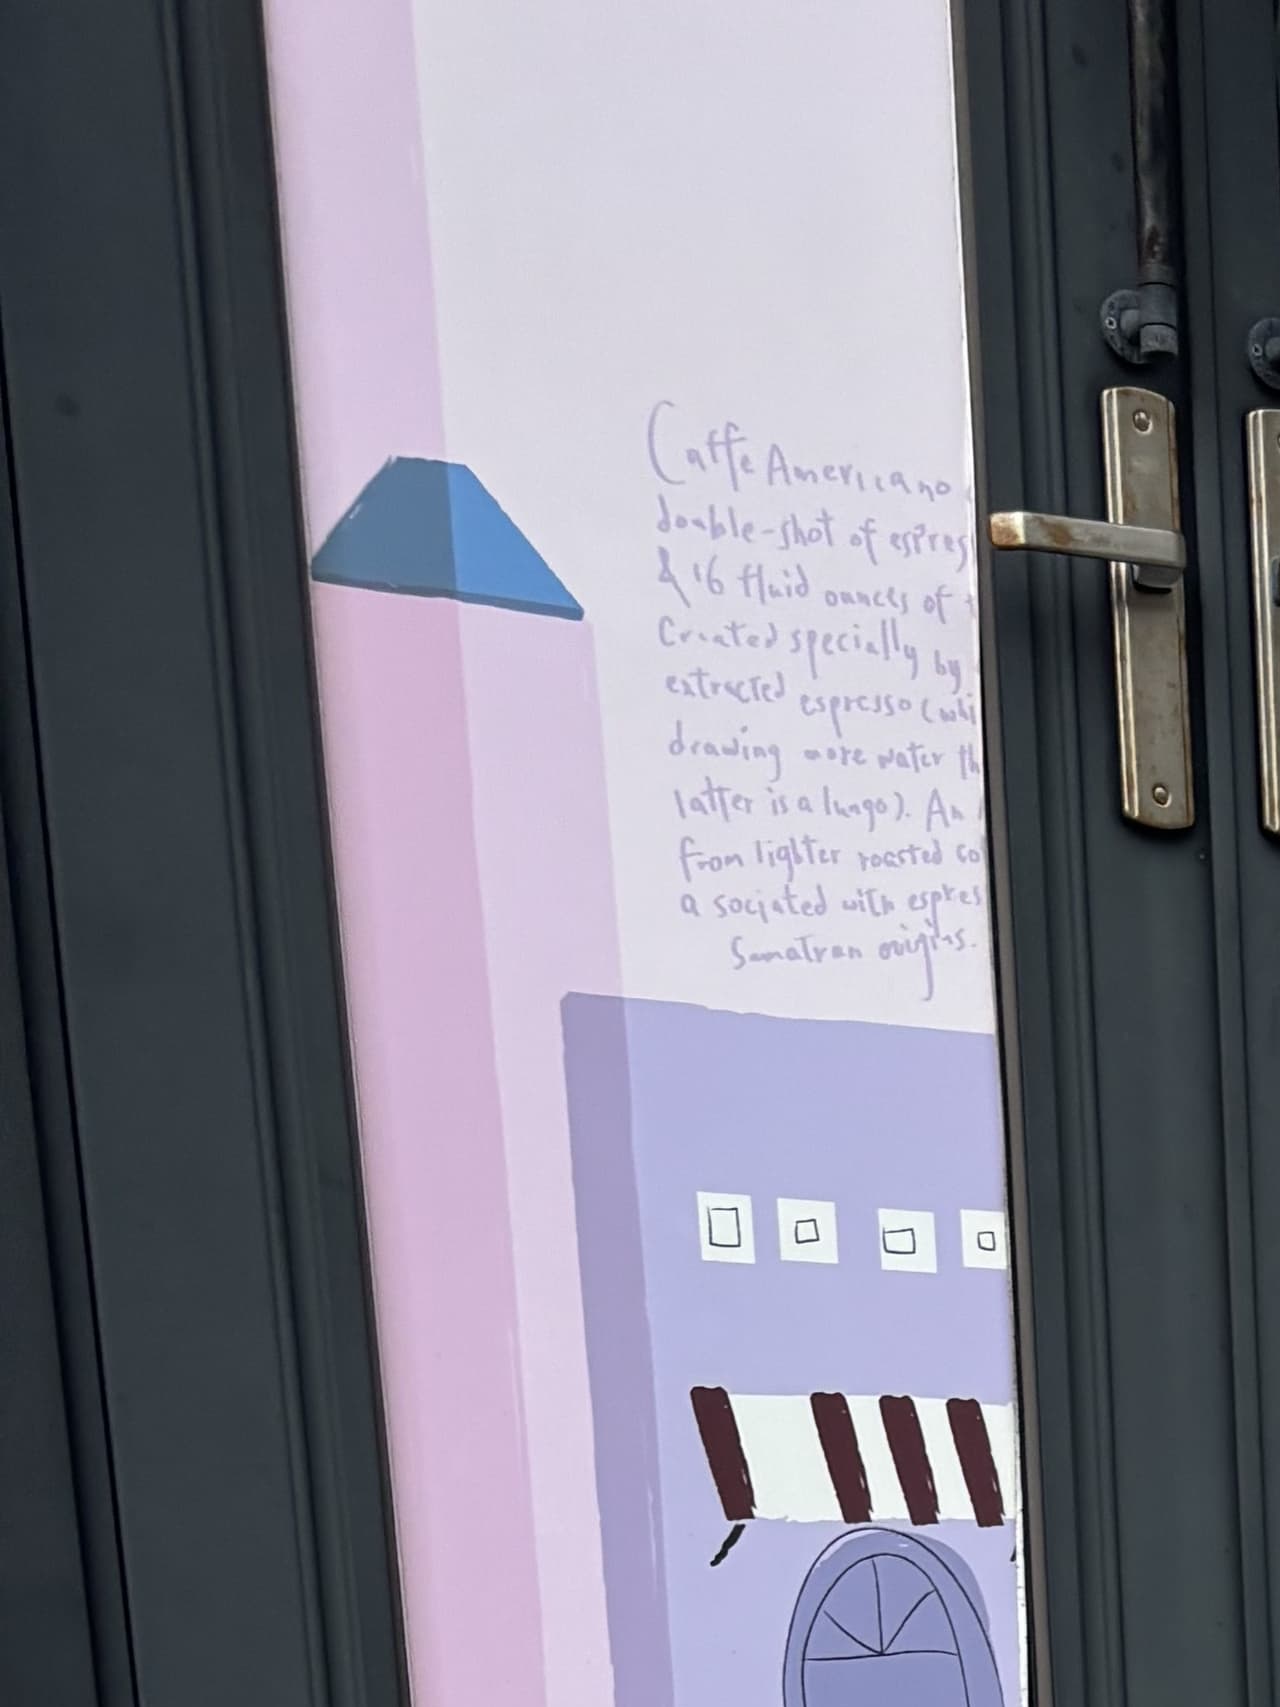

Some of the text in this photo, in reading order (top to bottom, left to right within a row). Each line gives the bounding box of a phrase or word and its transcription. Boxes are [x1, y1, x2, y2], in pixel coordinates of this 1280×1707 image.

[647, 399, 951, 502] Caffe Americano
[850, 517, 878, 566] of
[736, 563, 810, 606] fluid
[922, 583, 953, 625] of
[790, 617, 920, 681] specially
[934, 650, 962, 695] by
[665, 667, 786, 704] extracted
[800, 693, 912, 738] espresso
[668, 720, 782, 782] drawing
[877, 741, 944, 774] water
[673, 775, 754, 823] latter
[766, 786, 789, 816] is
[796, 795, 814, 815] a
[680, 835, 744, 883] from
[755, 833, 841, 883] lighter
[857, 839, 944, 871] roasted
[680, 892, 701, 917] a
[841, 888, 895, 917] with
